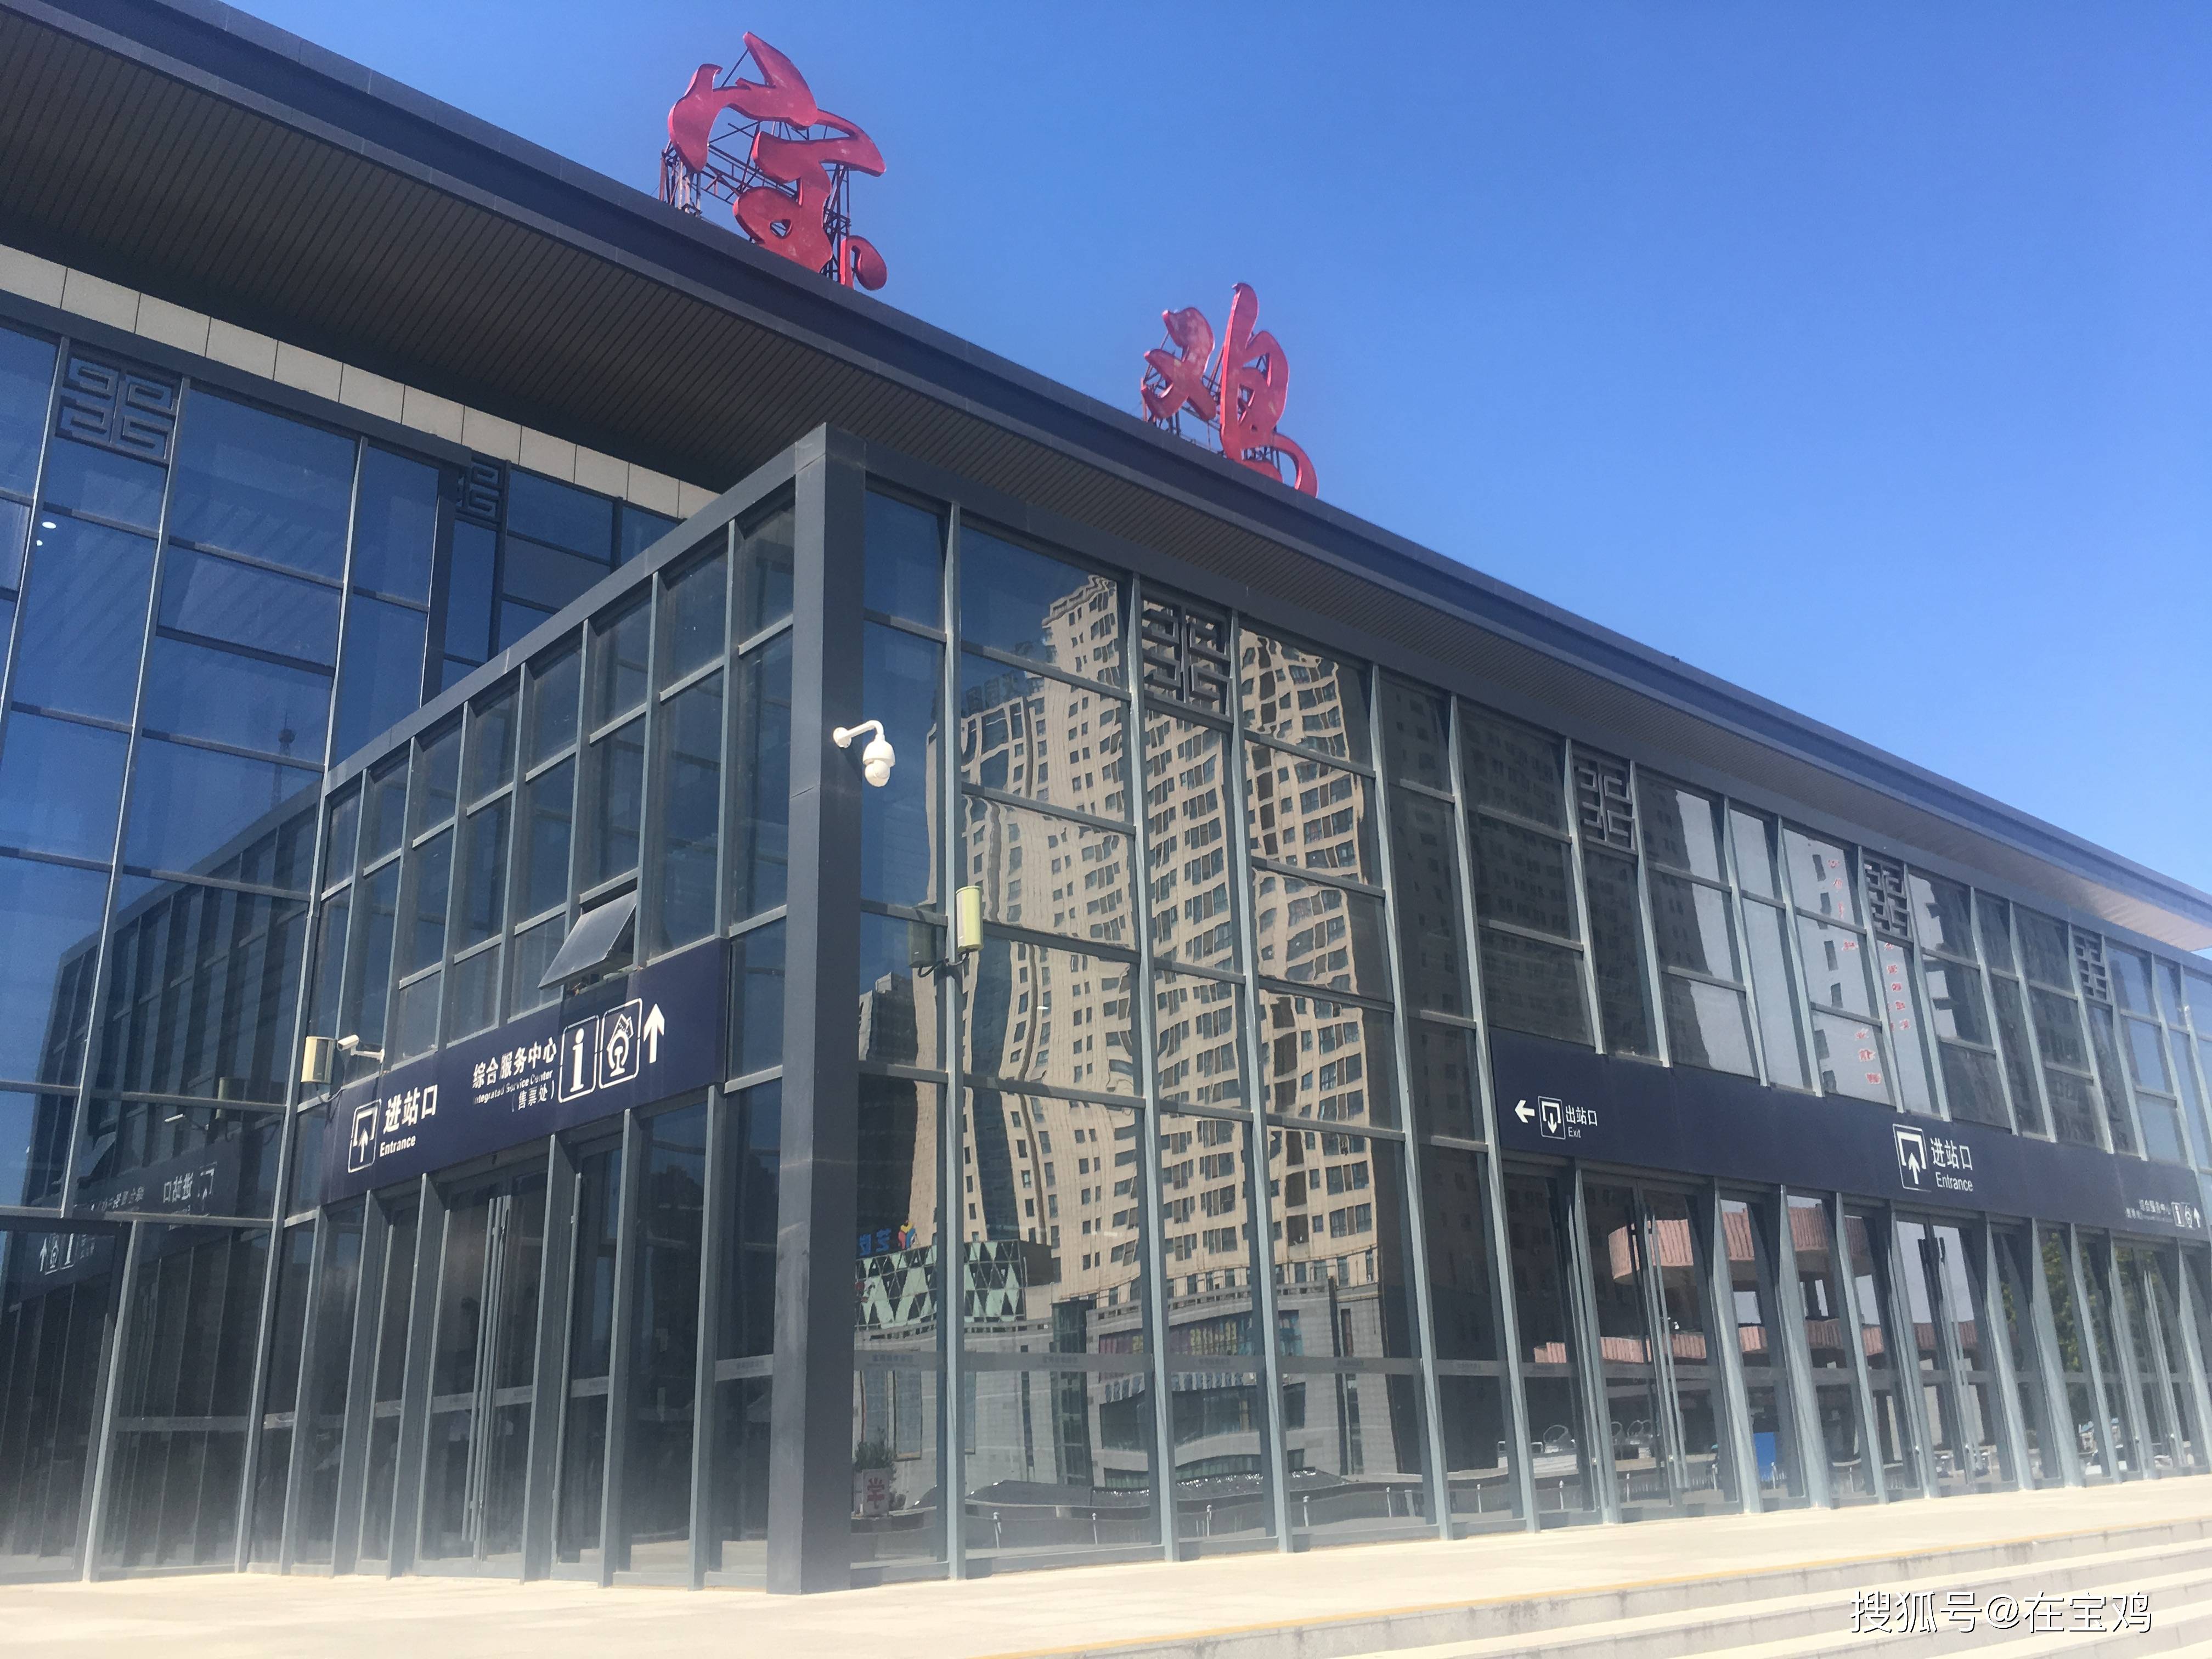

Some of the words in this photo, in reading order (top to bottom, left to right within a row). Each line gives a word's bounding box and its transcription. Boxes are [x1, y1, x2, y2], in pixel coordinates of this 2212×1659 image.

[472, 1036, 557, 1088] 综合服务中心
[473, 1086, 504, 1105] Integrated
[505, 1077, 529, 1093] Service
[530, 1070, 553, 1085] Center
[383, 1084, 438, 1135] 进站口
[1565, 1105, 1598, 1126] 出站口
[379, 1135, 416, 1157] Entrance
[1568, 1126, 1582, 1138] Exit
[1930, 1137, 1973, 1171] 进站口
[1935, 1171, 1973, 1192] Entrance
